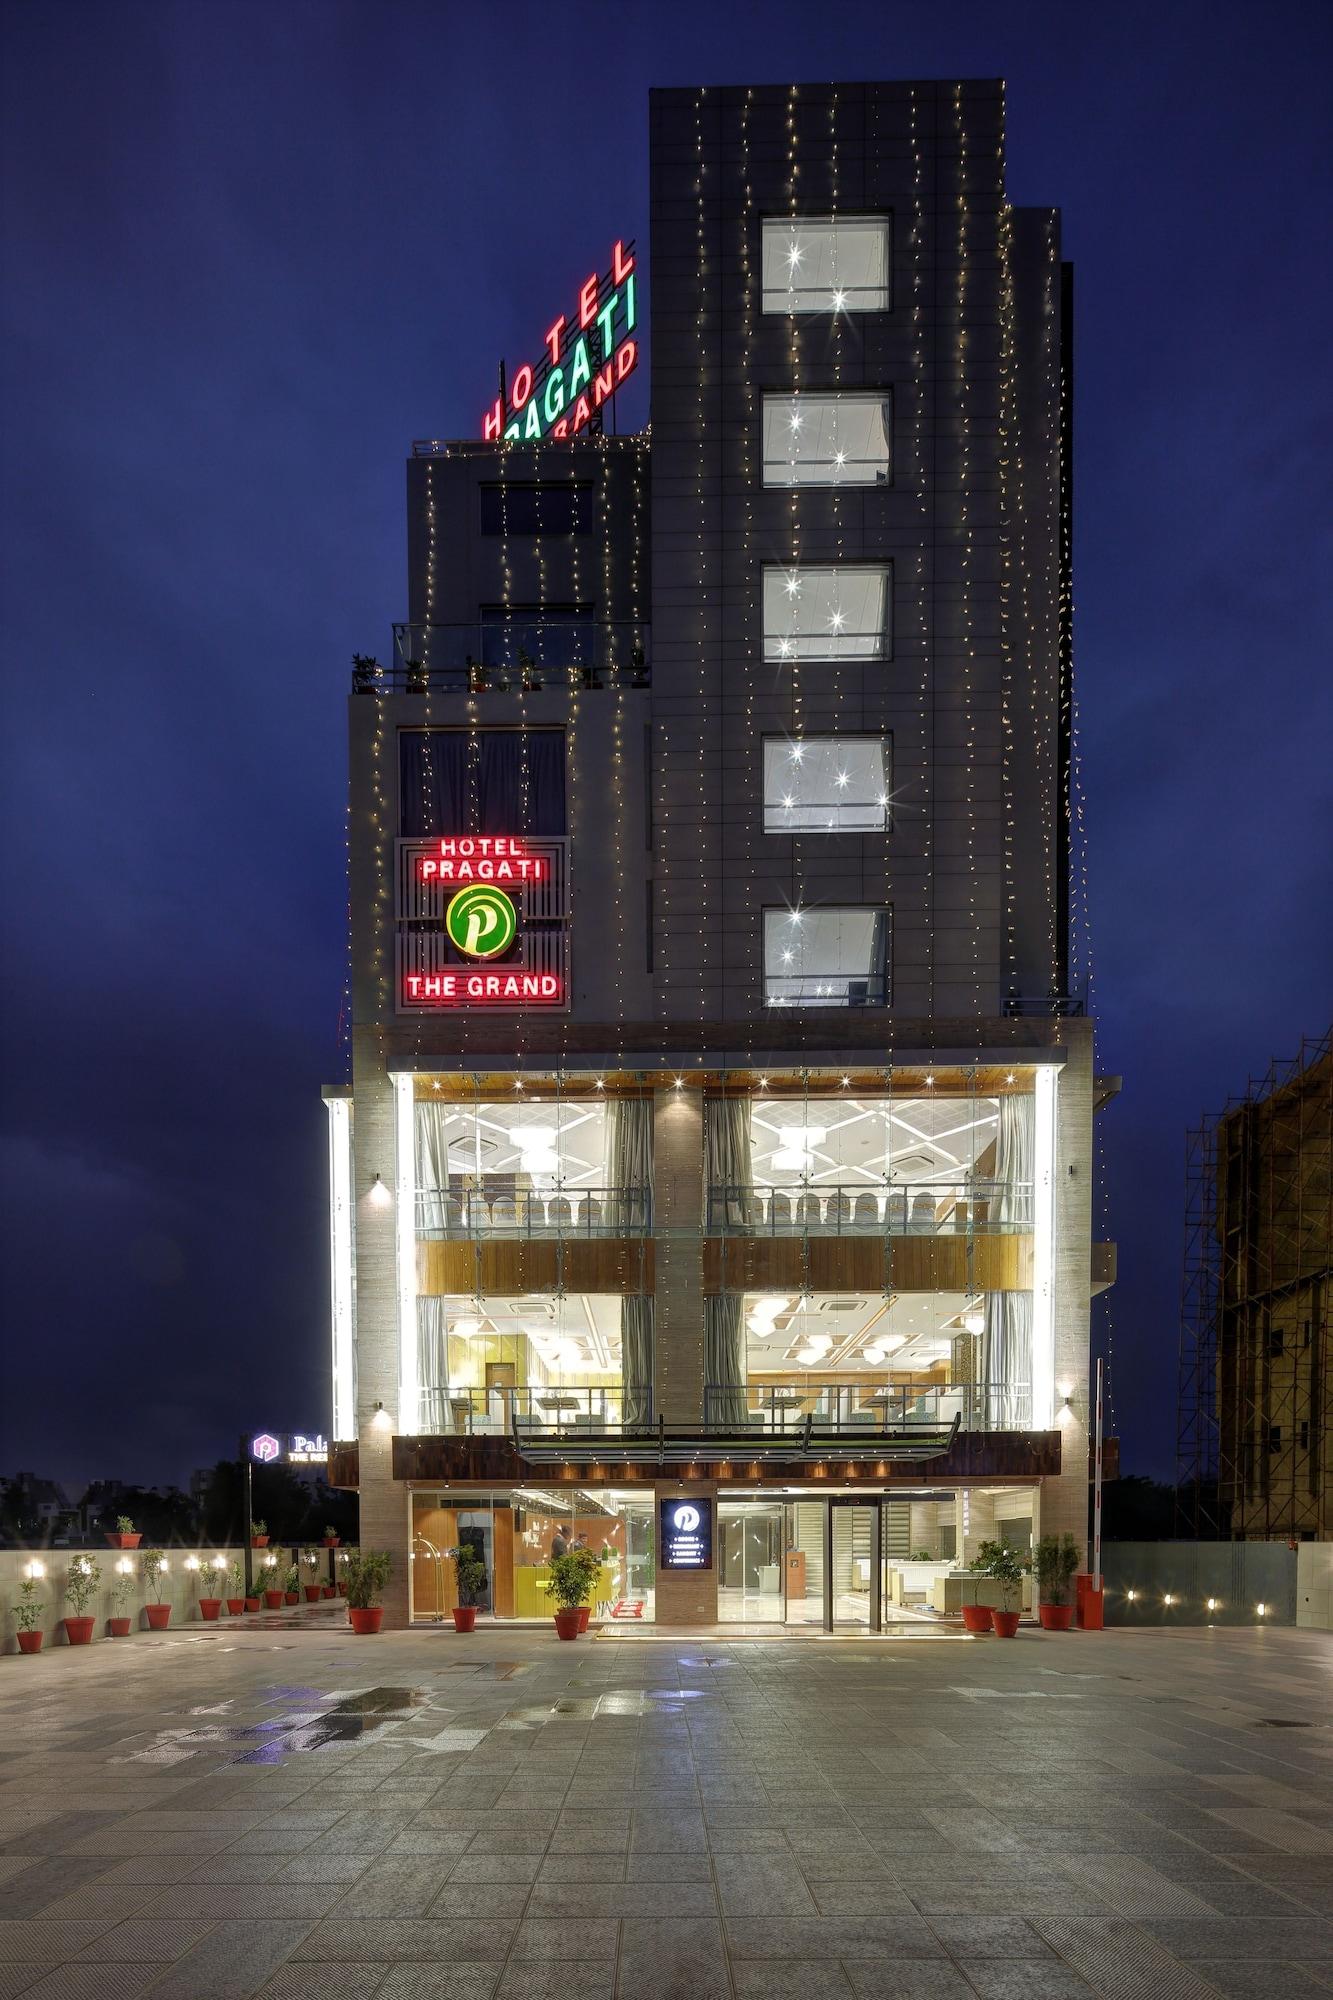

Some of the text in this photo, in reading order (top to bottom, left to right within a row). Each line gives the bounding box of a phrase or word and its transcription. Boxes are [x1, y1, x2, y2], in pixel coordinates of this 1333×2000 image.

[484, 240, 635, 440] HOTEL
[440, 838, 522, 857] HOTEL
[422, 860, 541, 879] PRAGATI
[407, 976, 557, 996] THE GRAND
